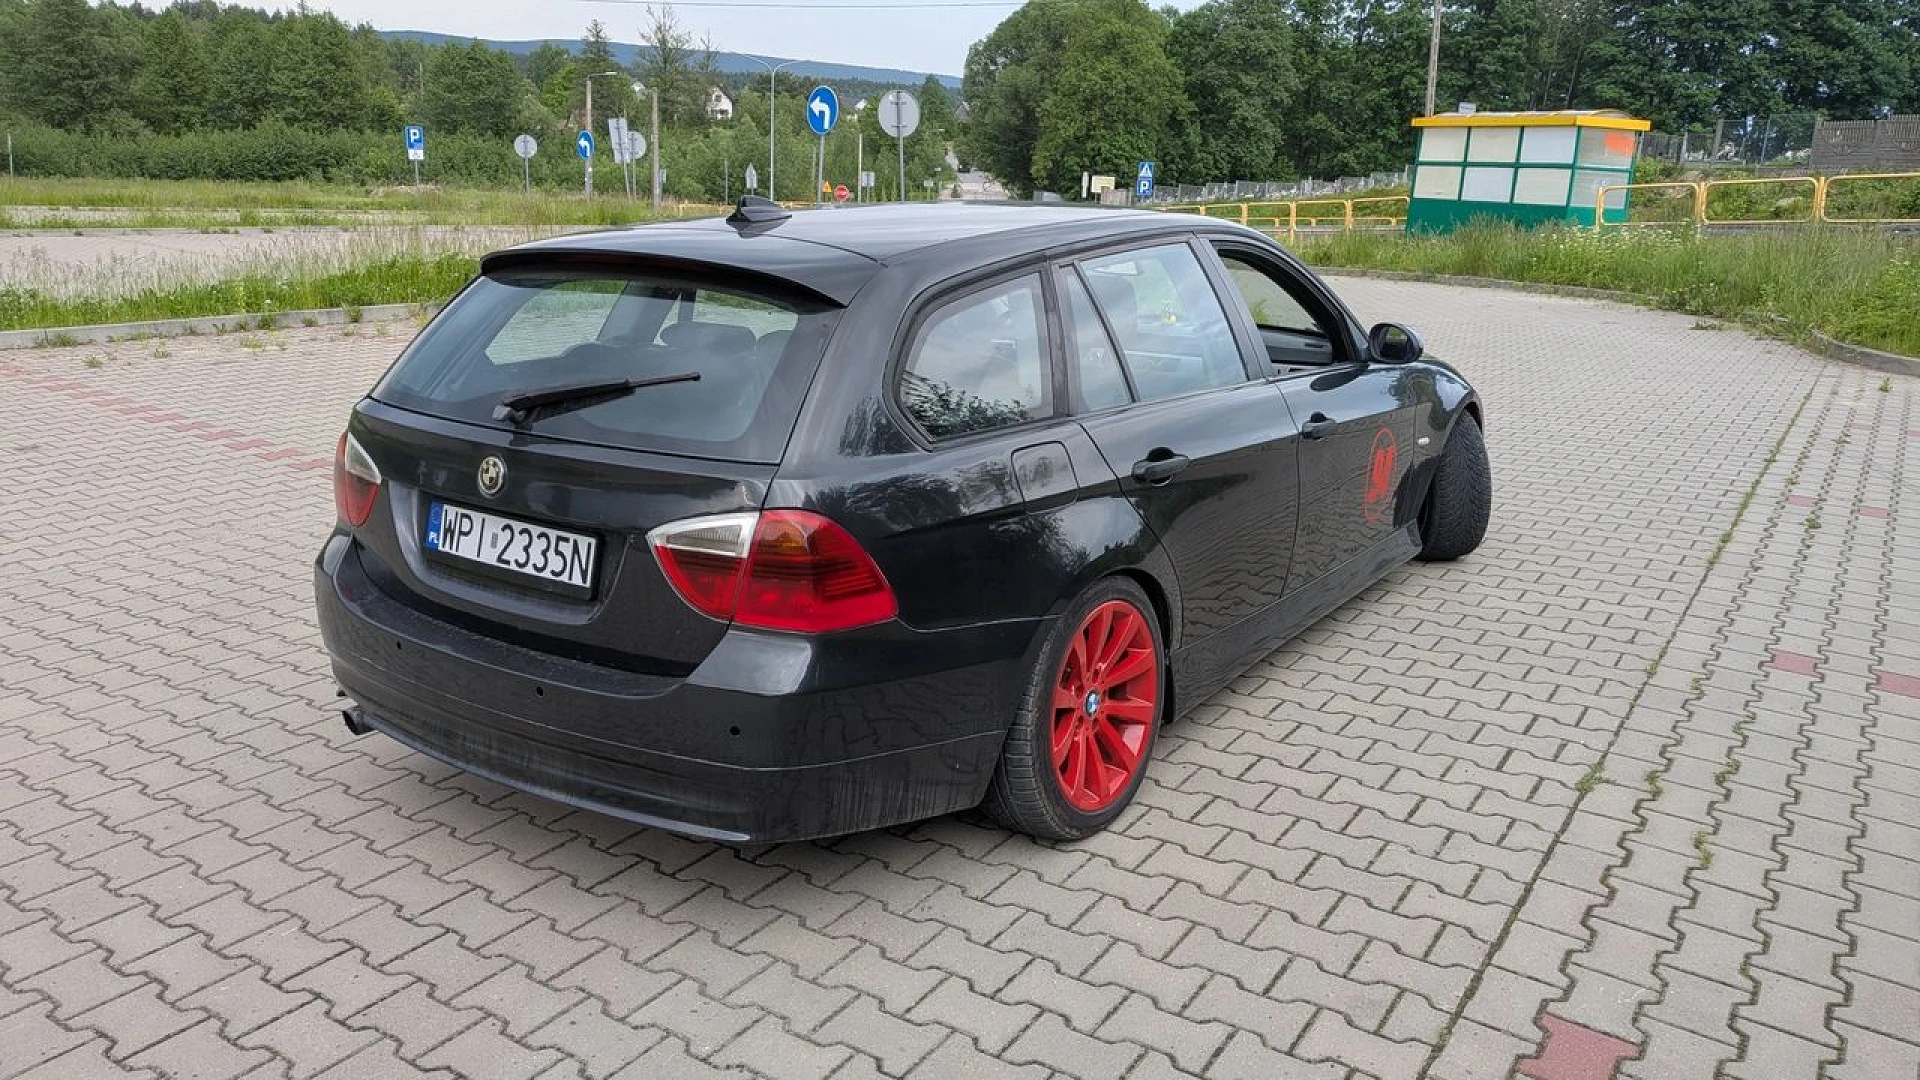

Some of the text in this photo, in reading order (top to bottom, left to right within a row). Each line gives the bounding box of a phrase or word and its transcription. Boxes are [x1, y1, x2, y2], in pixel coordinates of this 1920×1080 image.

[411, 129, 420, 143] P
[1140, 181, 1149, 192] P
[428, 530, 439, 544] PL
[495, 523, 592, 584] 2335N
